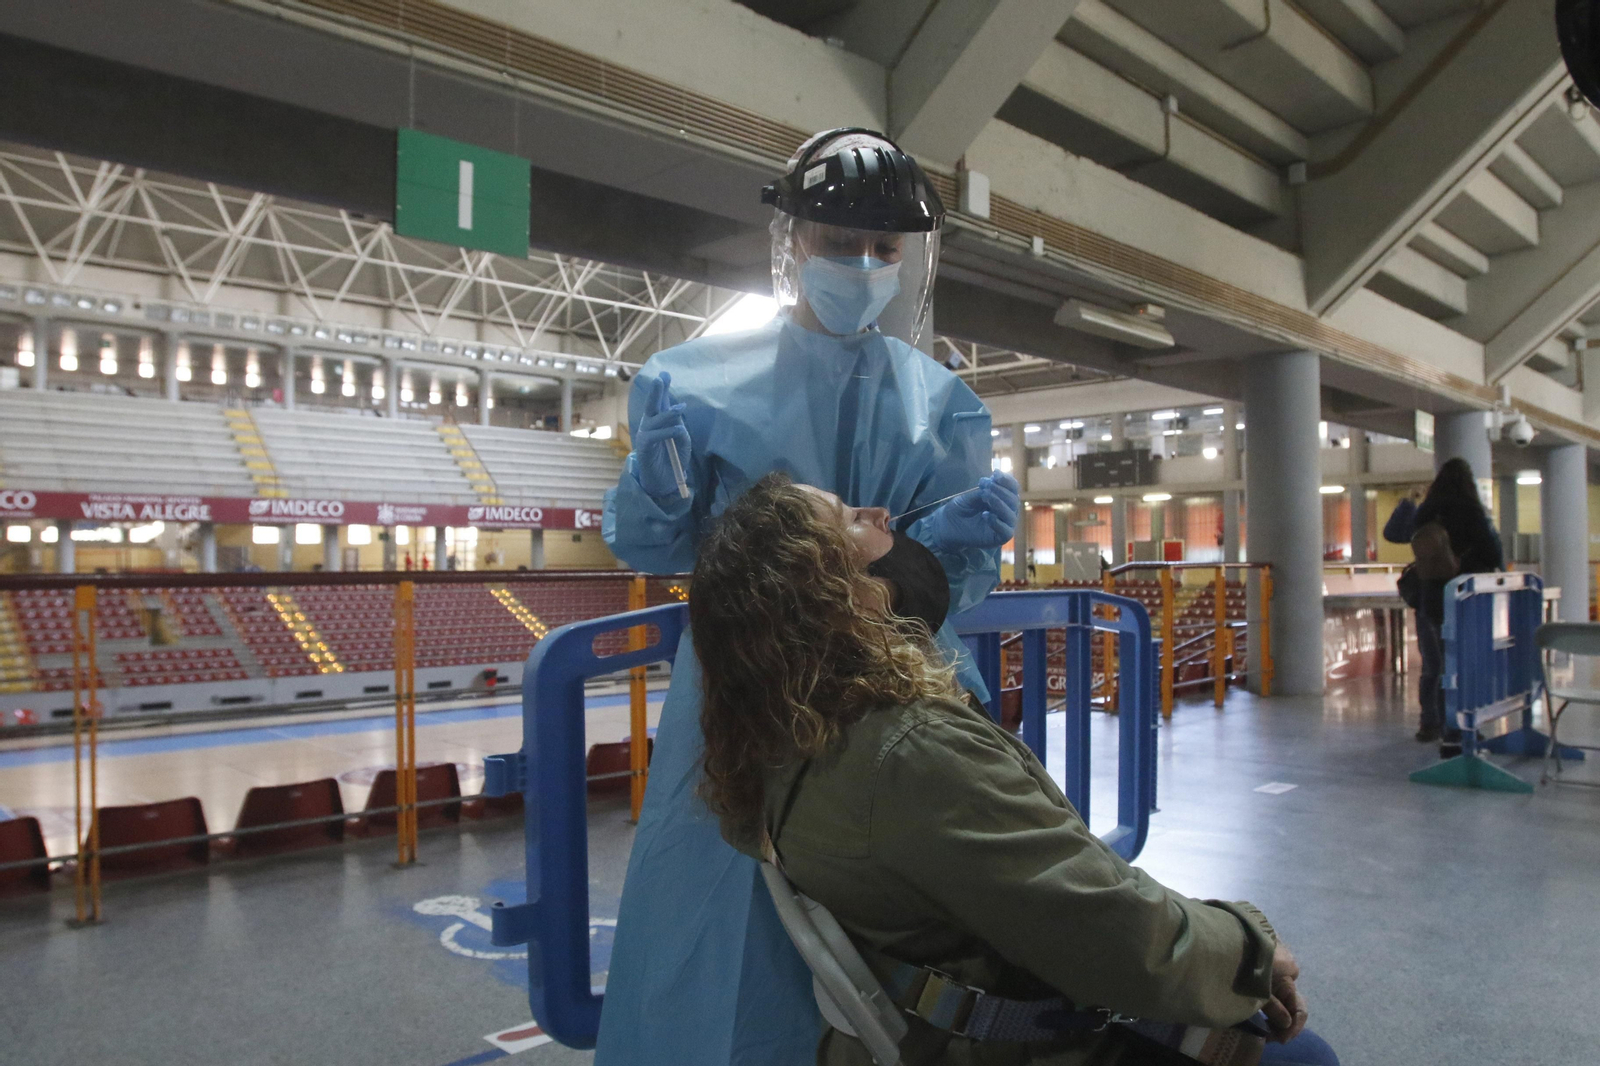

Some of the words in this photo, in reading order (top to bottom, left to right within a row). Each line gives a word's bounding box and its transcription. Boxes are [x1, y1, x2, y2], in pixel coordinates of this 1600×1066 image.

[80, 502, 136, 520] VISTA
[139, 503, 212, 521] ALEGRE
[271, 500, 345, 517] IMDECO
[485, 506, 543, 521] IMDECO
